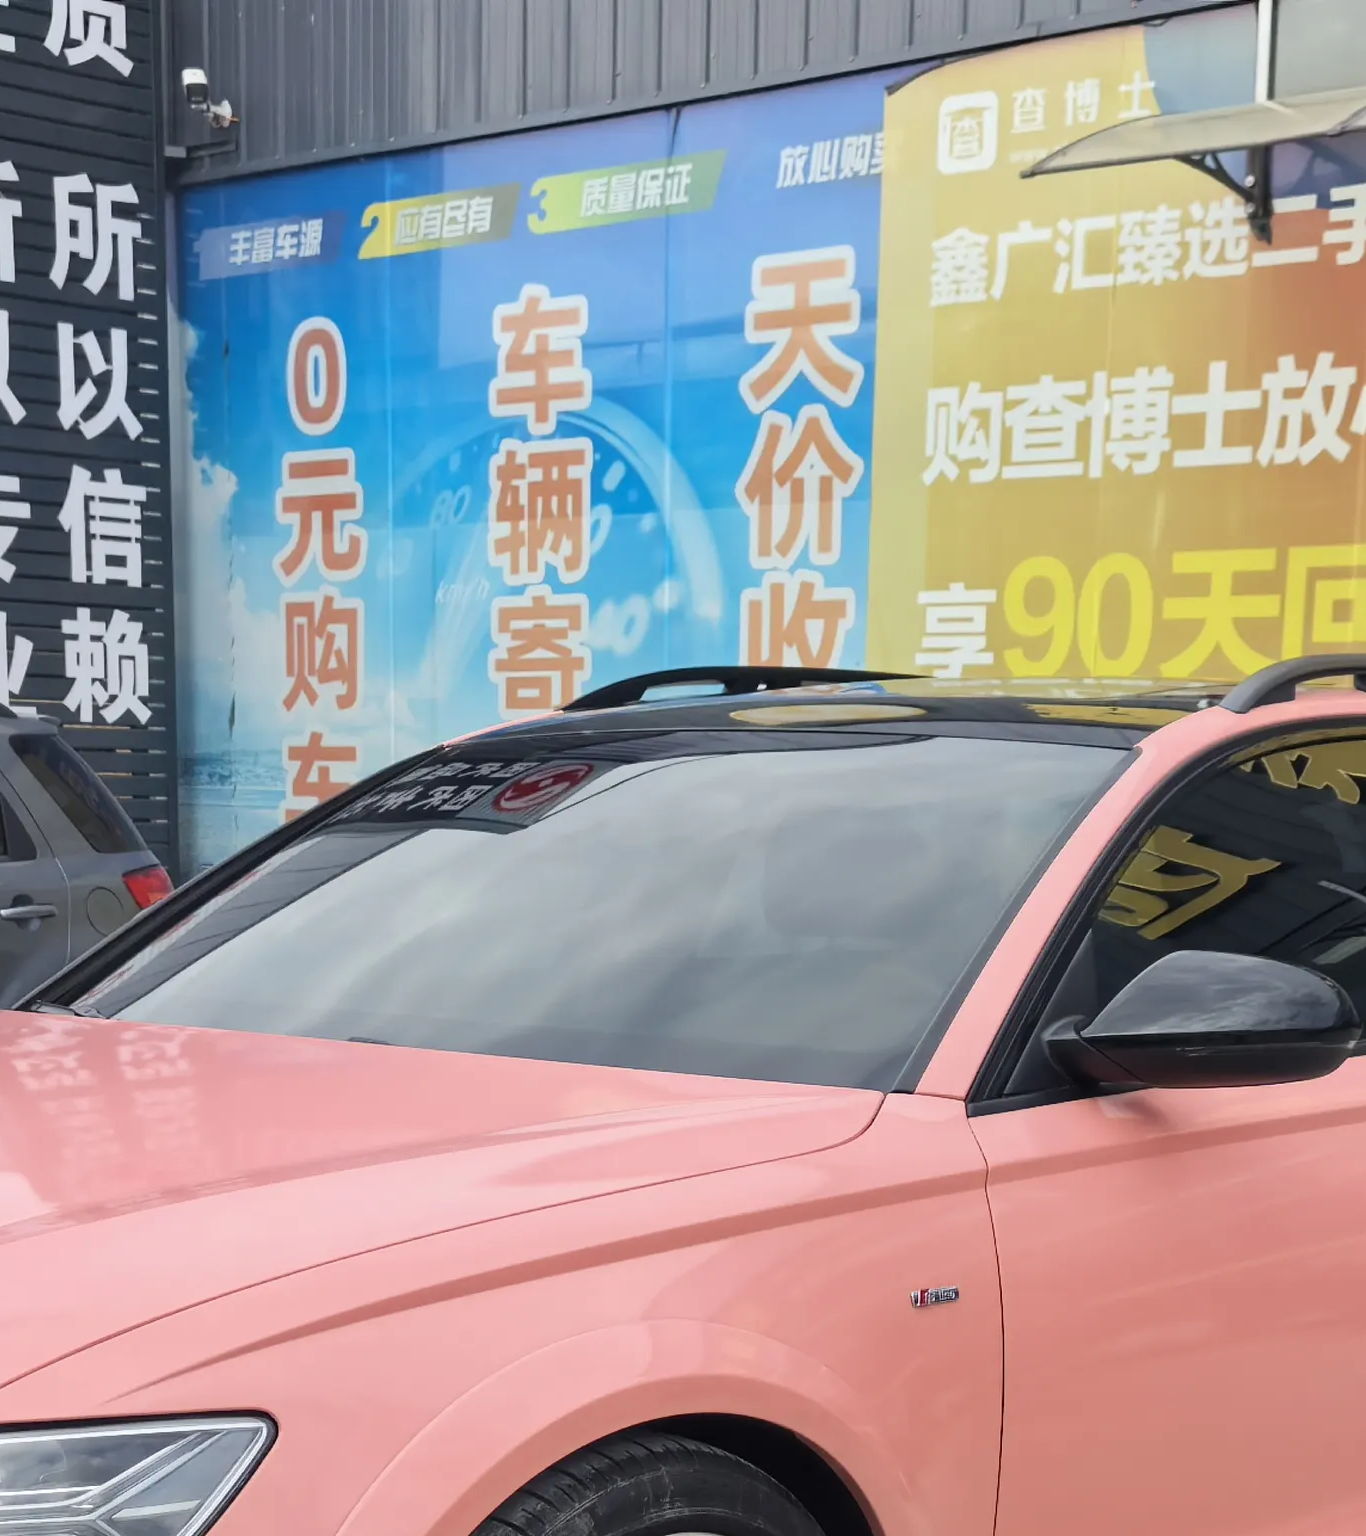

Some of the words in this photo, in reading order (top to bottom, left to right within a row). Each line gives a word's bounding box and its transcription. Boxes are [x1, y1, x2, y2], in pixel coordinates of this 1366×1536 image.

[1010, 70, 1156, 134] 查博士
[579, 162, 694, 218] 质量保证
[393, 196, 494, 247] 应有尽有
[49, 173, 153, 726] 所以信赖
